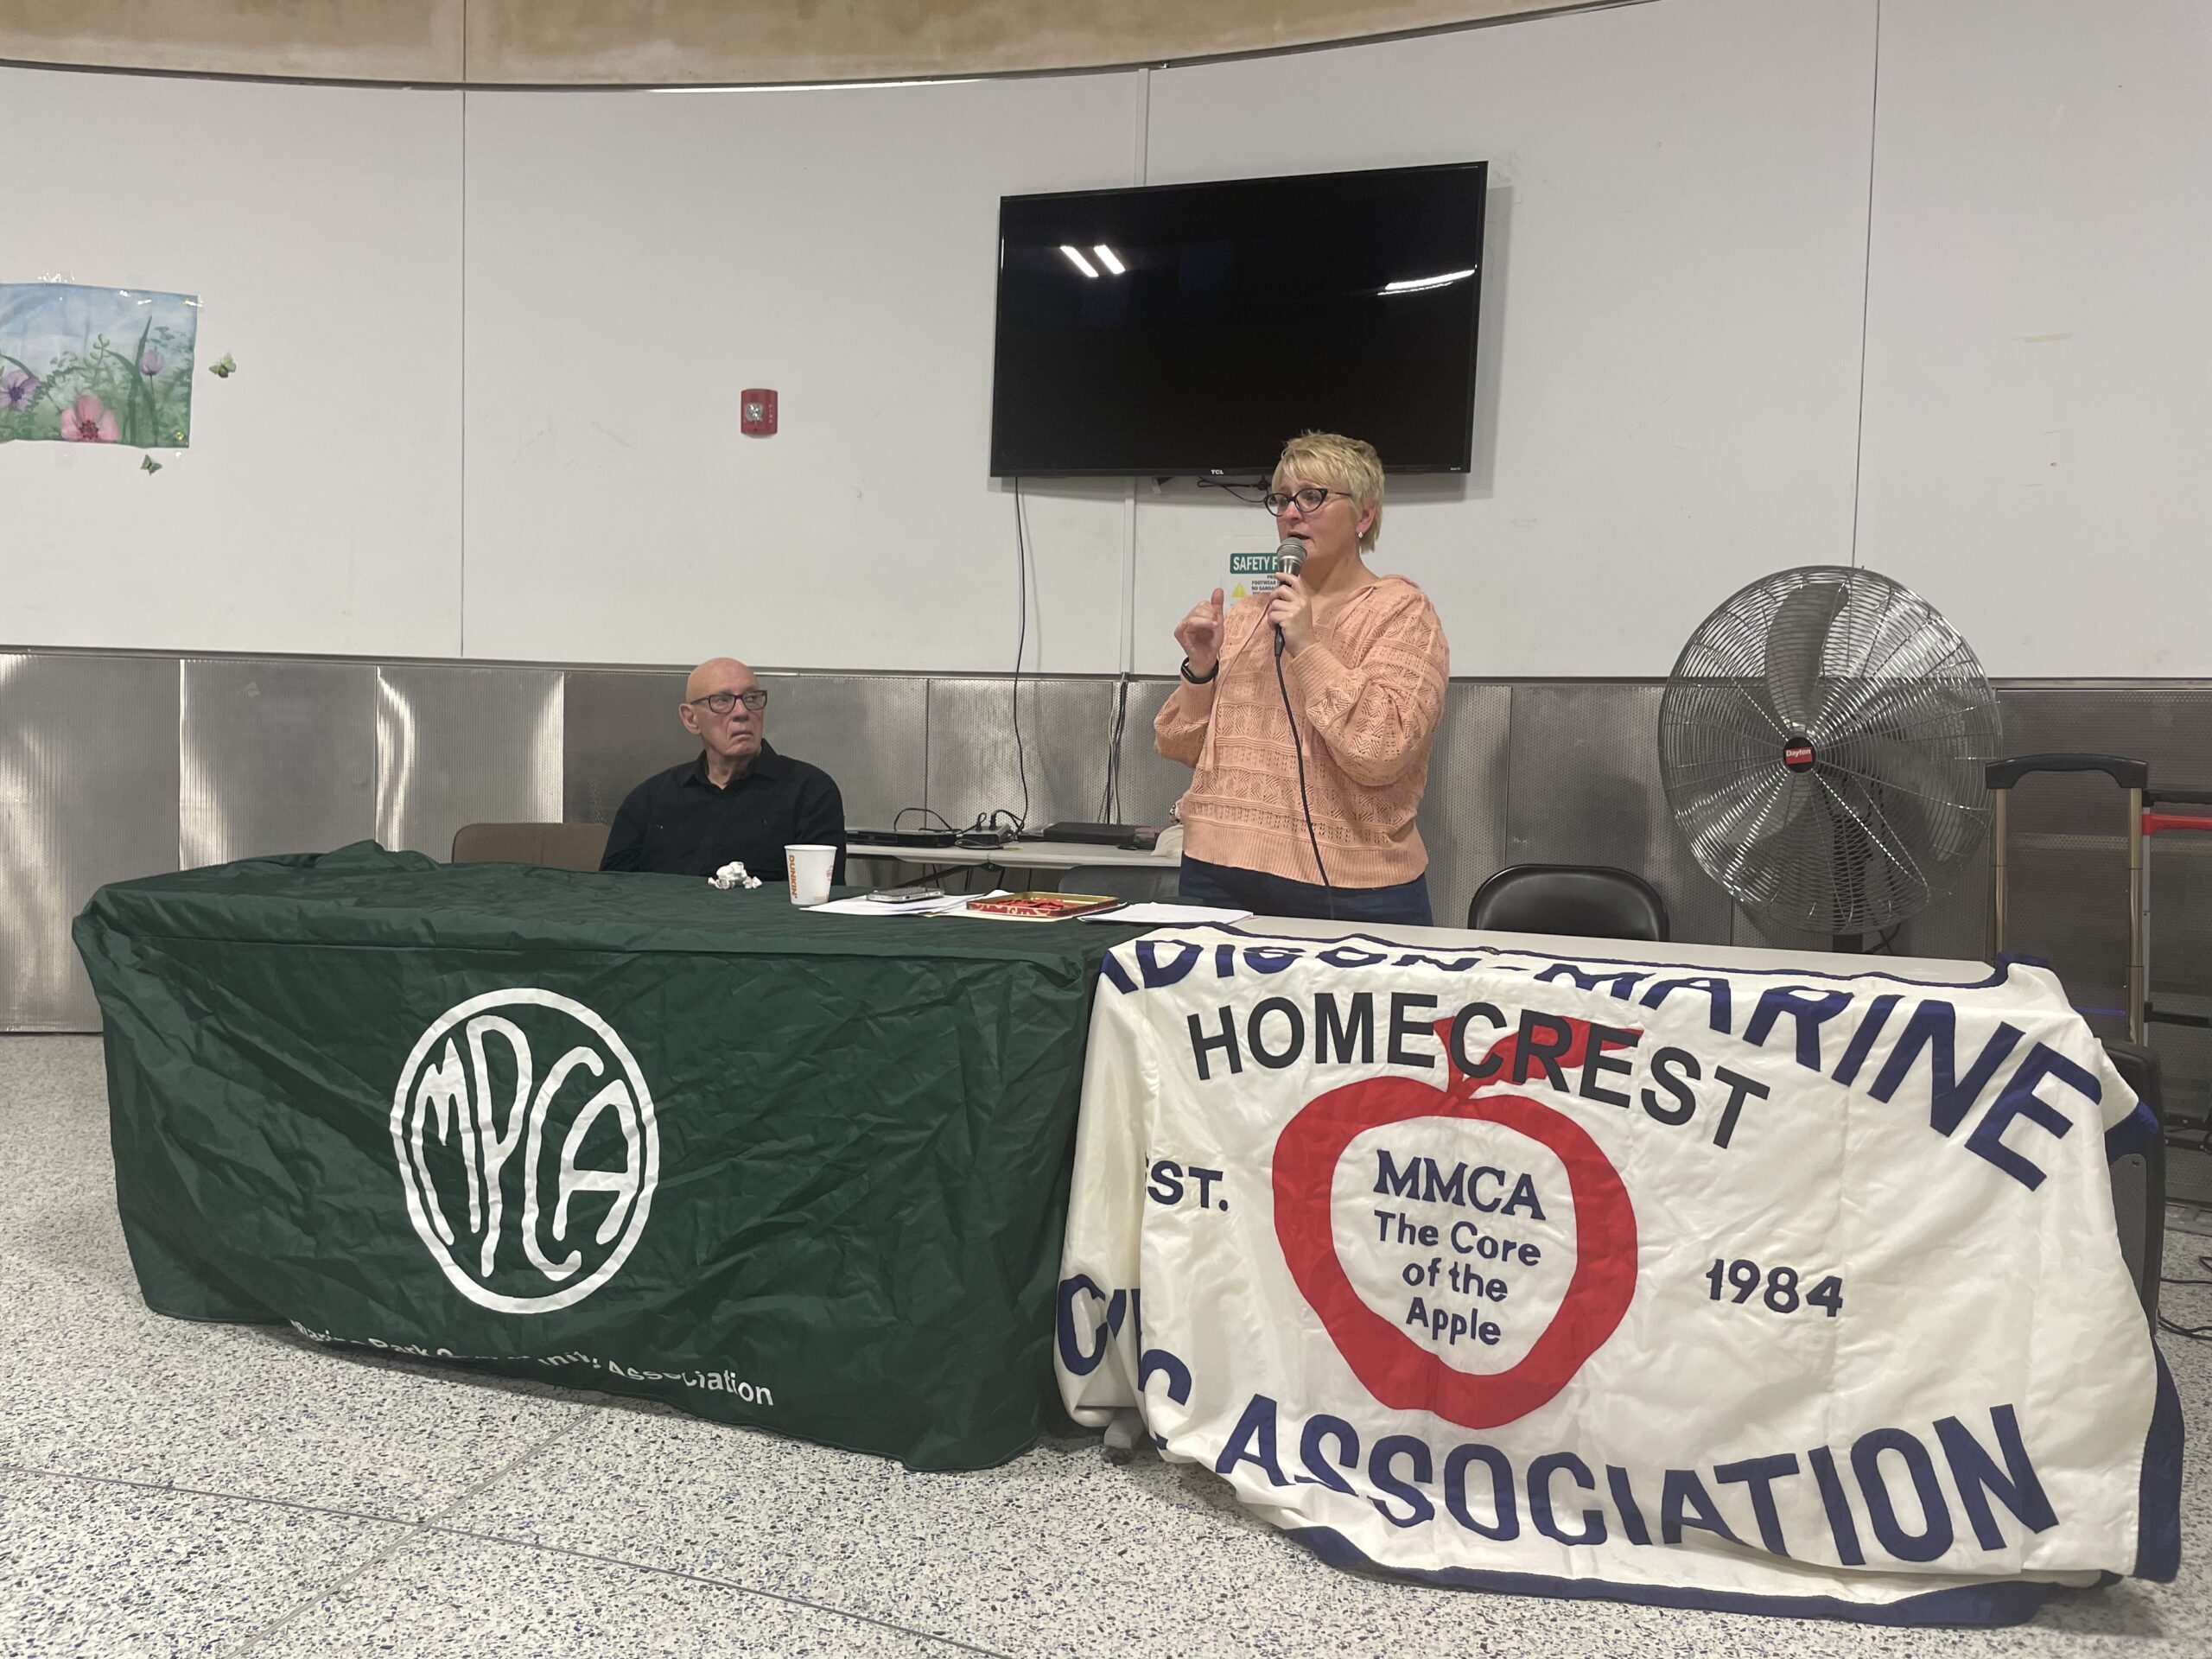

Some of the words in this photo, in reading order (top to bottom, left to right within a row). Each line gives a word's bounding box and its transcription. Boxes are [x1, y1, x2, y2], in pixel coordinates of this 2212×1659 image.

[1233, 556, 1270, 570] SAFETY
[1785, 748, 1811, 759] Dayton
[1186, 992, 1770, 1149] HOMECREST
[1145, 1153, 1229, 1211] ST.
[1373, 1149, 1546, 1221] MMCA
[1374, 1210, 1439, 1246] The
[1451, 1221, 1541, 1267] Core
[1402, 1257, 1442, 1287] of
[1448, 1262, 1508, 1302] the
[1706, 1258, 1844, 1318] 1984
[1406, 1297, 1502, 1346] Apple
[1215, 1393, 2060, 1567] ASSOCIATION
